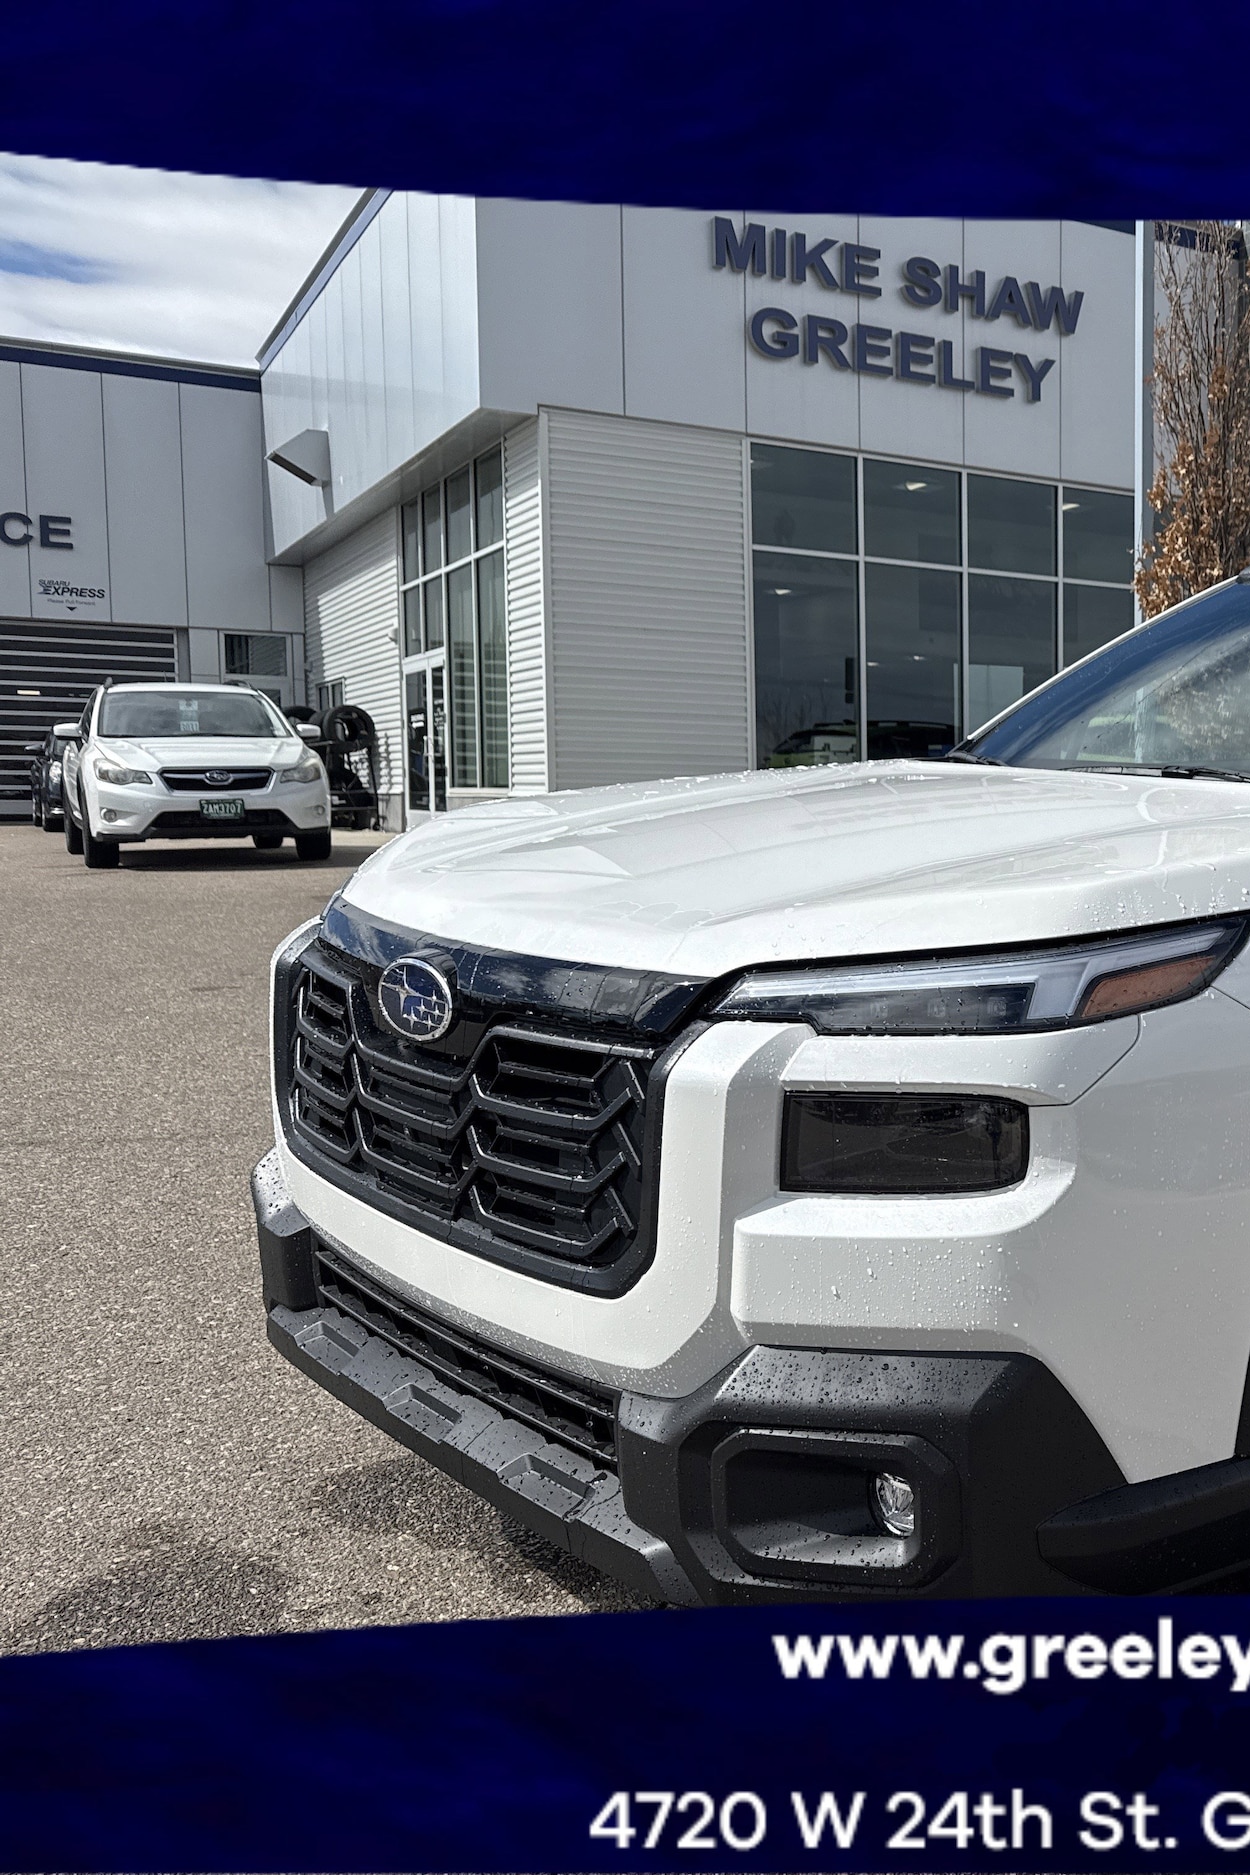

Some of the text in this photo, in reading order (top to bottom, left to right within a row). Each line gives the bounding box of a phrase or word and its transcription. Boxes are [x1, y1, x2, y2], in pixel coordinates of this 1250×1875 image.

[711, 215, 1085, 336] MIKE SHAW
[748, 306, 1056, 403] GREELEY
[38, 579, 70, 587] SUBARU
[41, 586, 106, 599] EXPRESS
